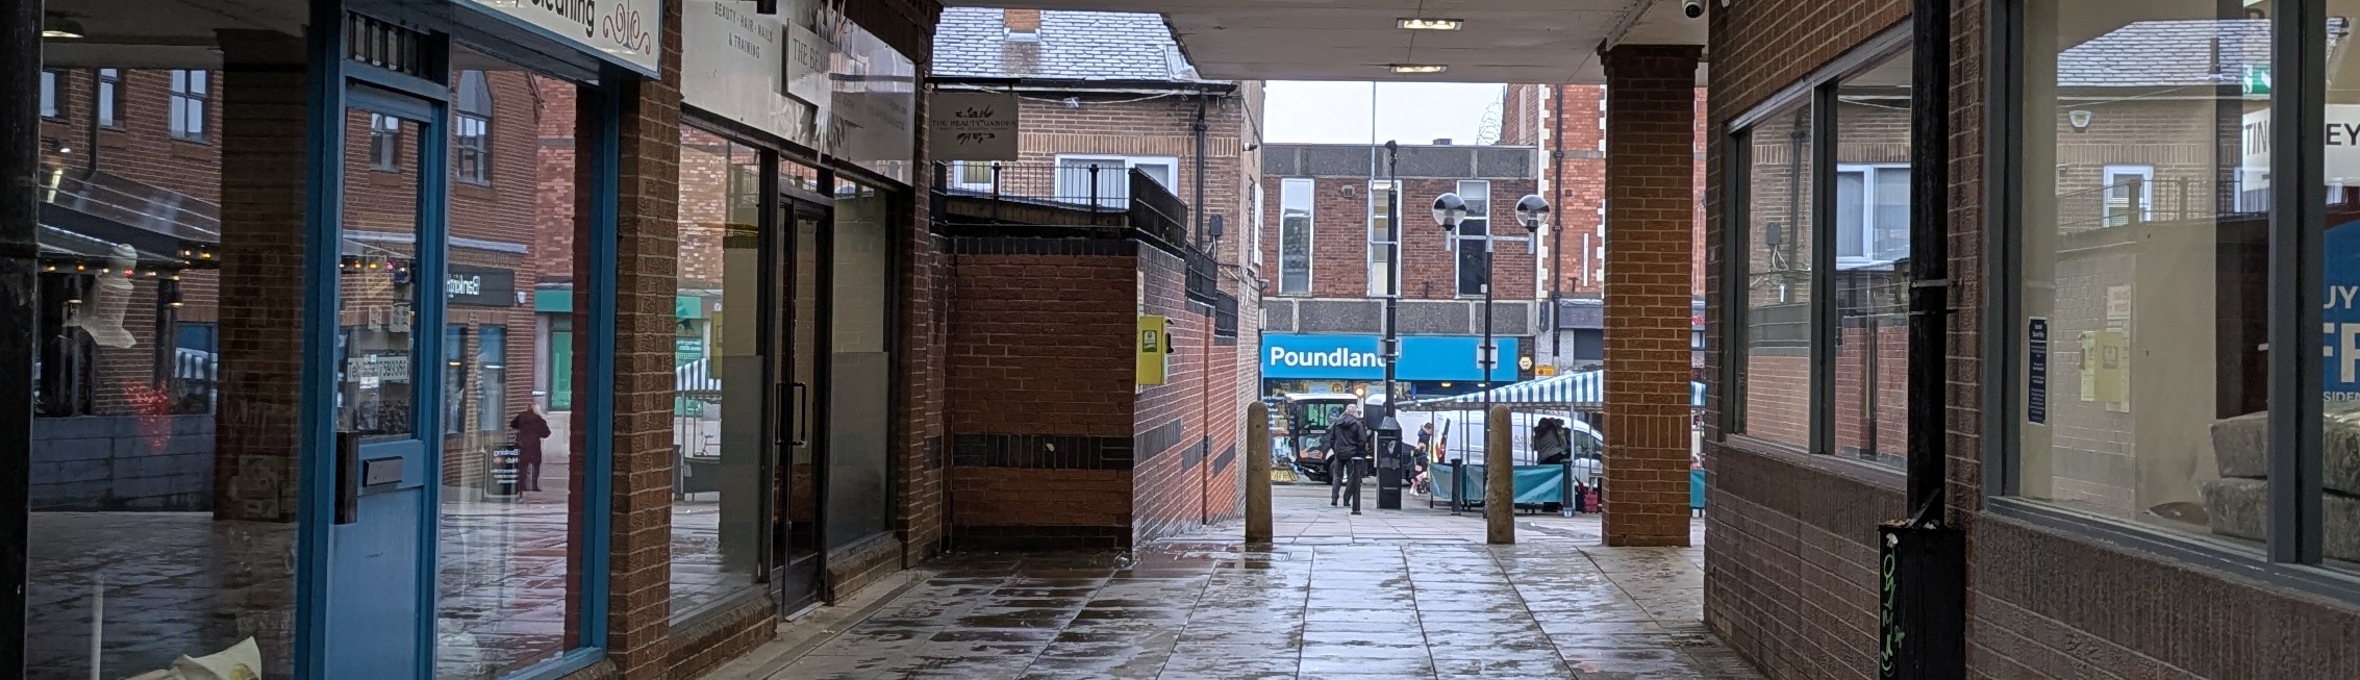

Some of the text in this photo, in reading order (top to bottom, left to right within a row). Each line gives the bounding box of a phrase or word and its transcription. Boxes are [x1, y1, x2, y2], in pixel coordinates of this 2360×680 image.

[714, 2, 773, 44] BEAUTY HAIR NAILS
[734, 35, 760, 59] TRAINING
[793, 38, 808, 66] THE
